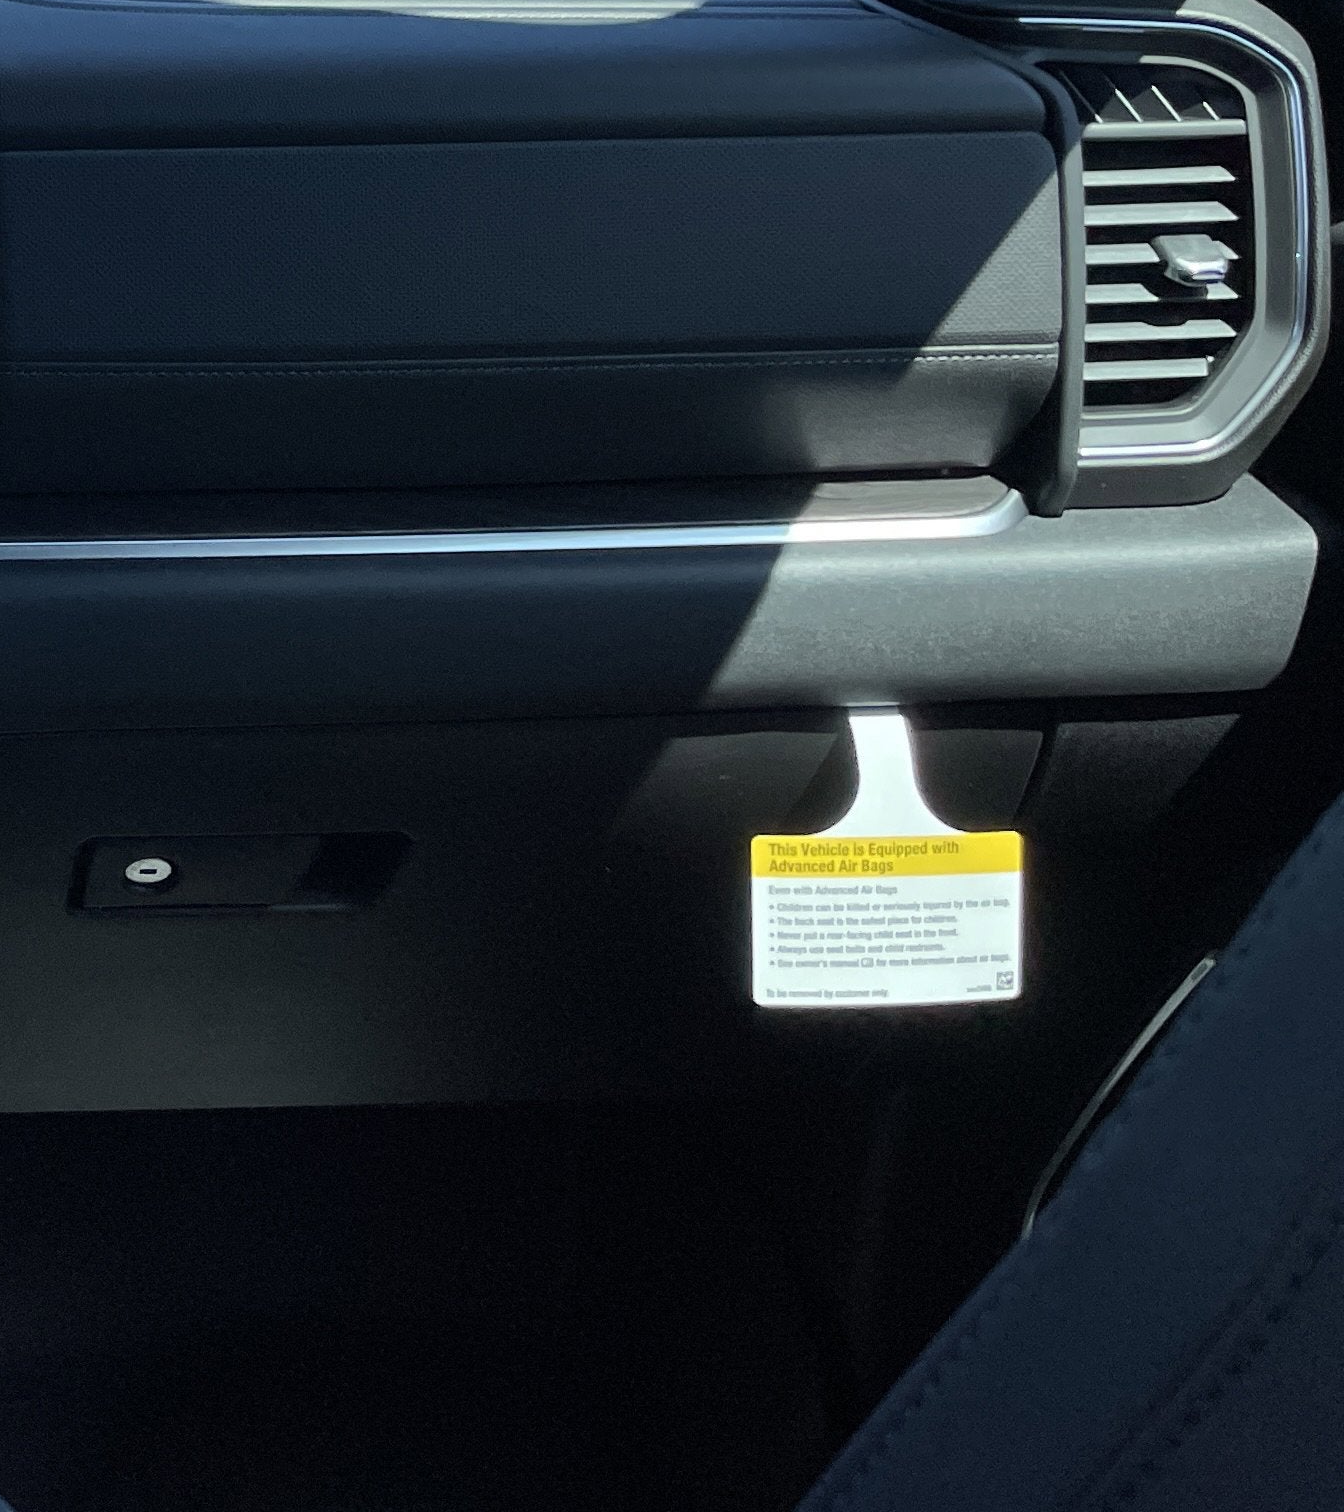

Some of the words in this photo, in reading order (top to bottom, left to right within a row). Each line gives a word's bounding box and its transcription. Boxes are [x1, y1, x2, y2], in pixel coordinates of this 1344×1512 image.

[768, 842, 797, 856] This
[801, 842, 849, 856] Vehicle
[852, 842, 865, 856] is
[868, 840, 928, 858] Equipped
[931, 840, 959, 855] with
[768, 858, 835, 873] Advanced
[838, 858, 858, 872] Air
[861, 858, 894, 875] Bags
